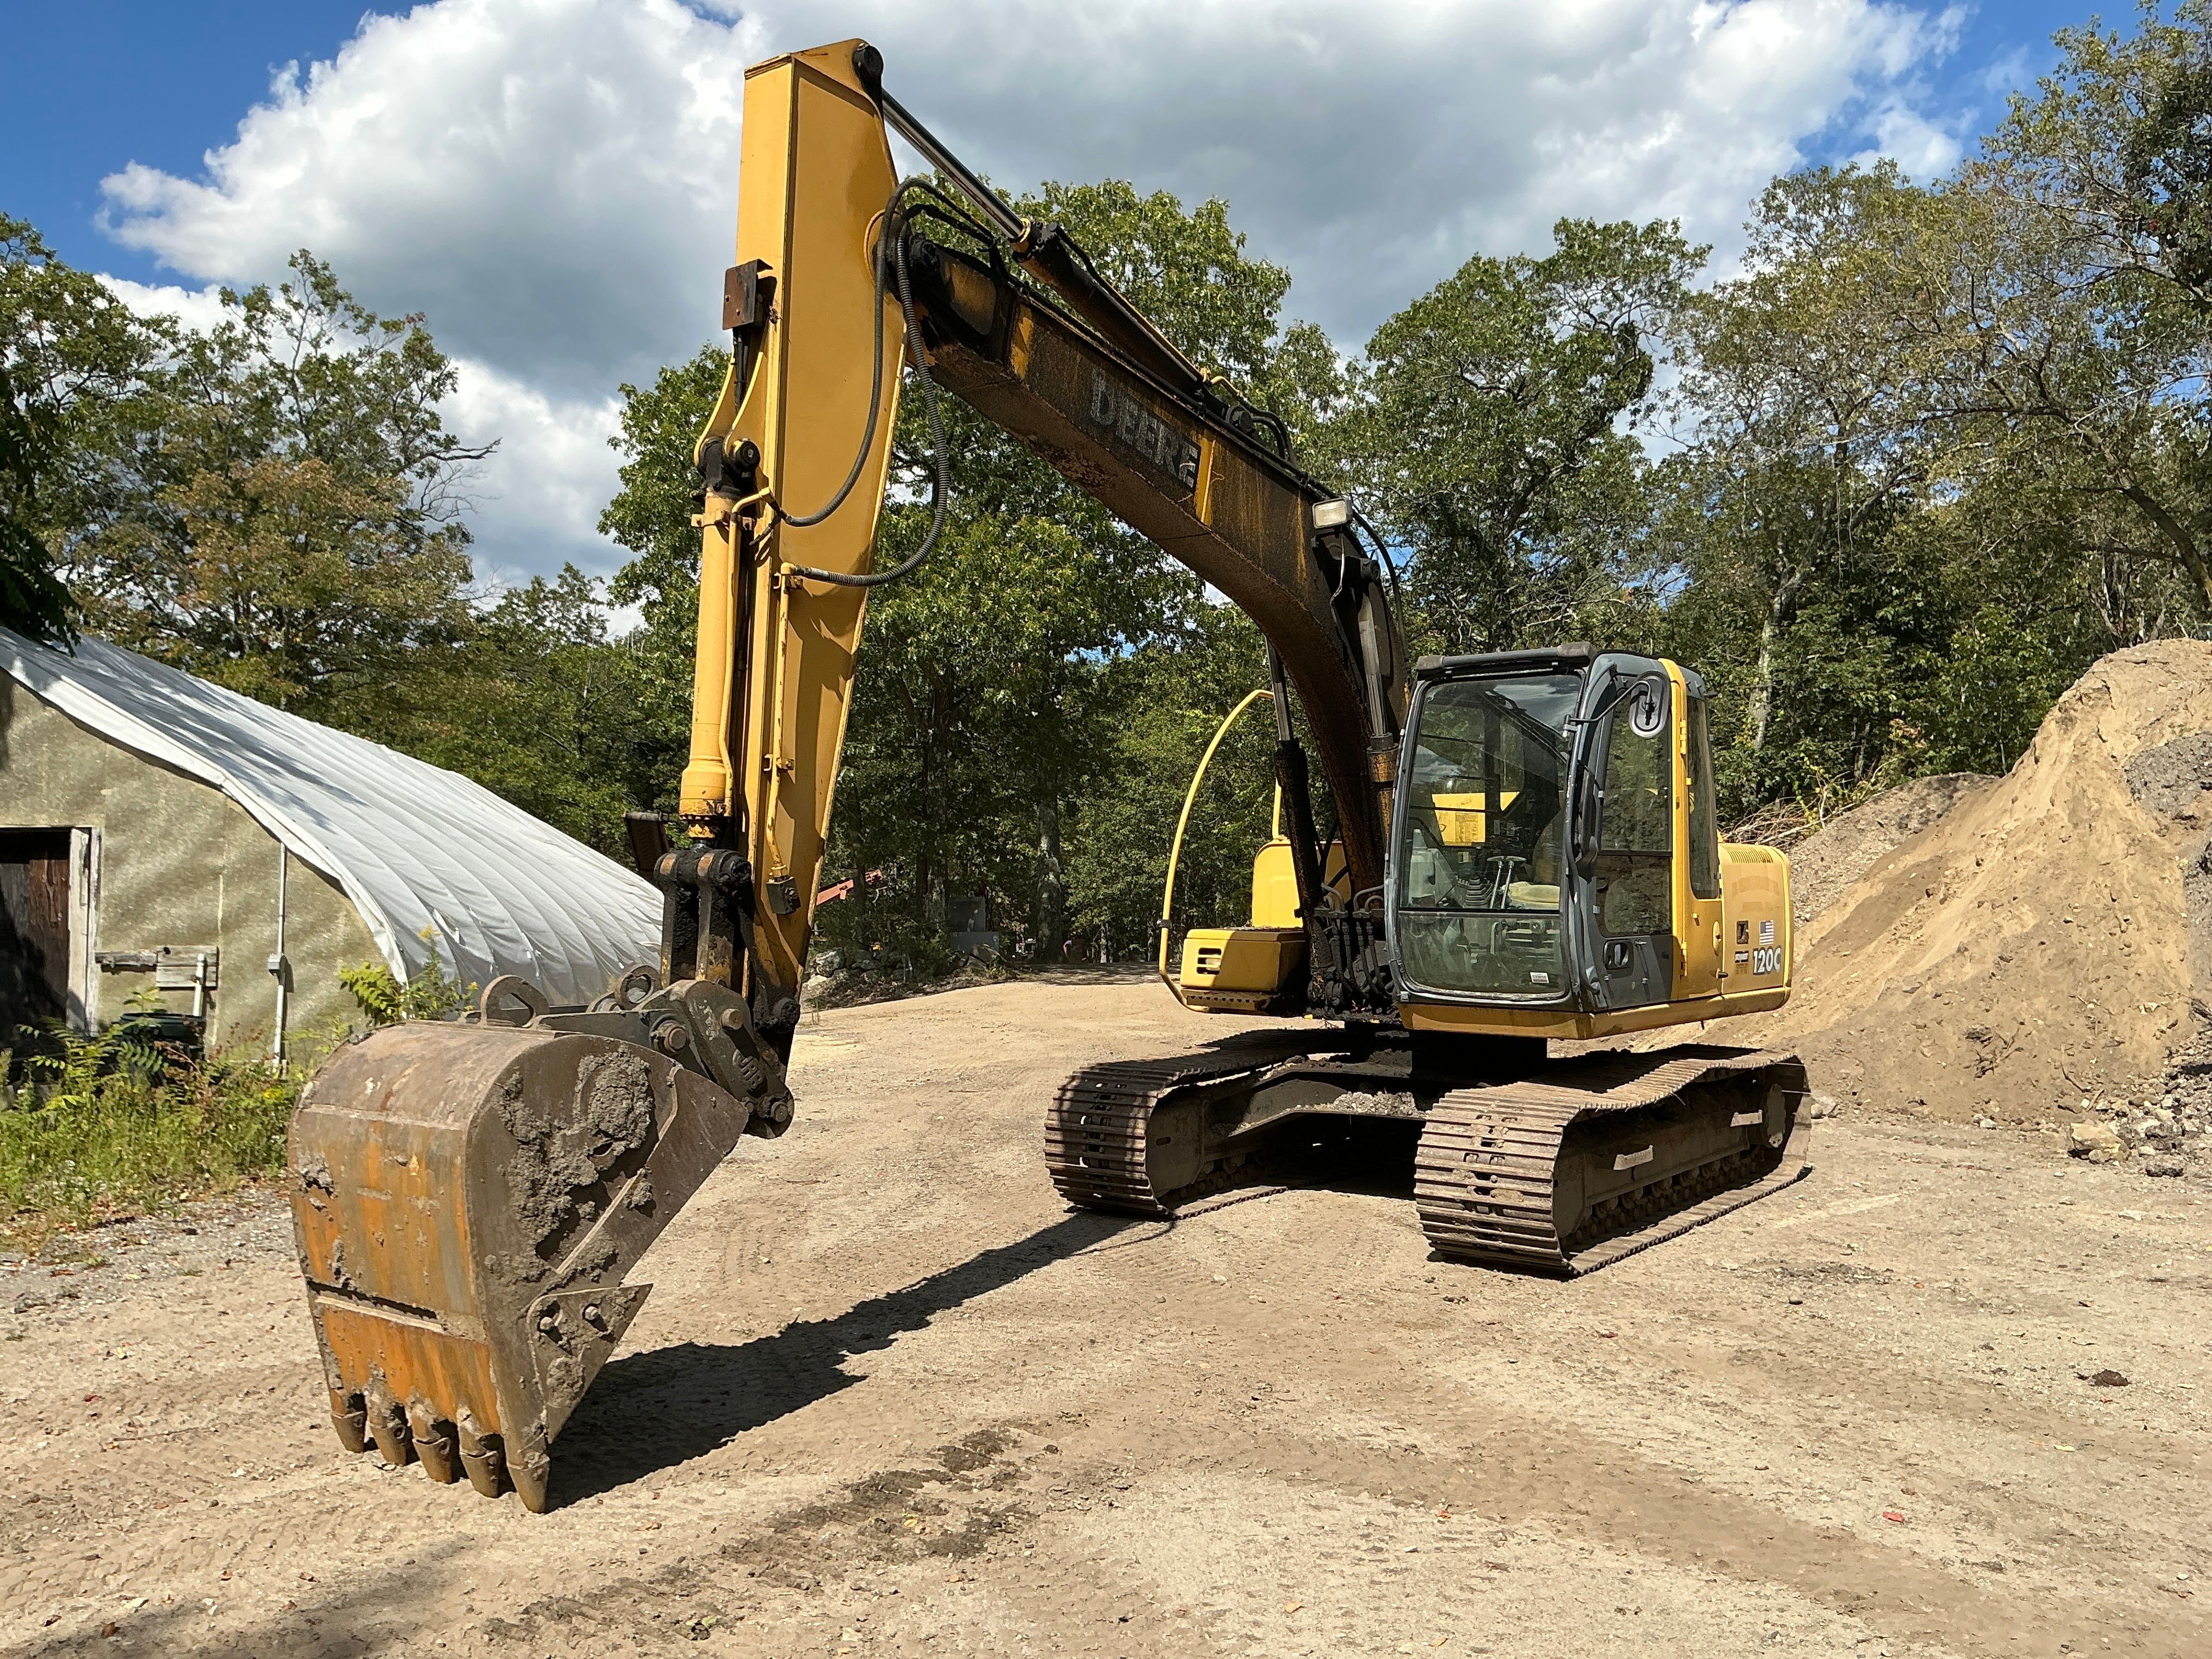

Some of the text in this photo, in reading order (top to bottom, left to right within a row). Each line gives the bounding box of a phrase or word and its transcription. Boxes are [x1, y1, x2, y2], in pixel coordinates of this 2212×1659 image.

[1091, 369, 1198, 488] DEERE
[1753, 947, 1781, 973] 120C
[735, 1051, 764, 1090] JRB
